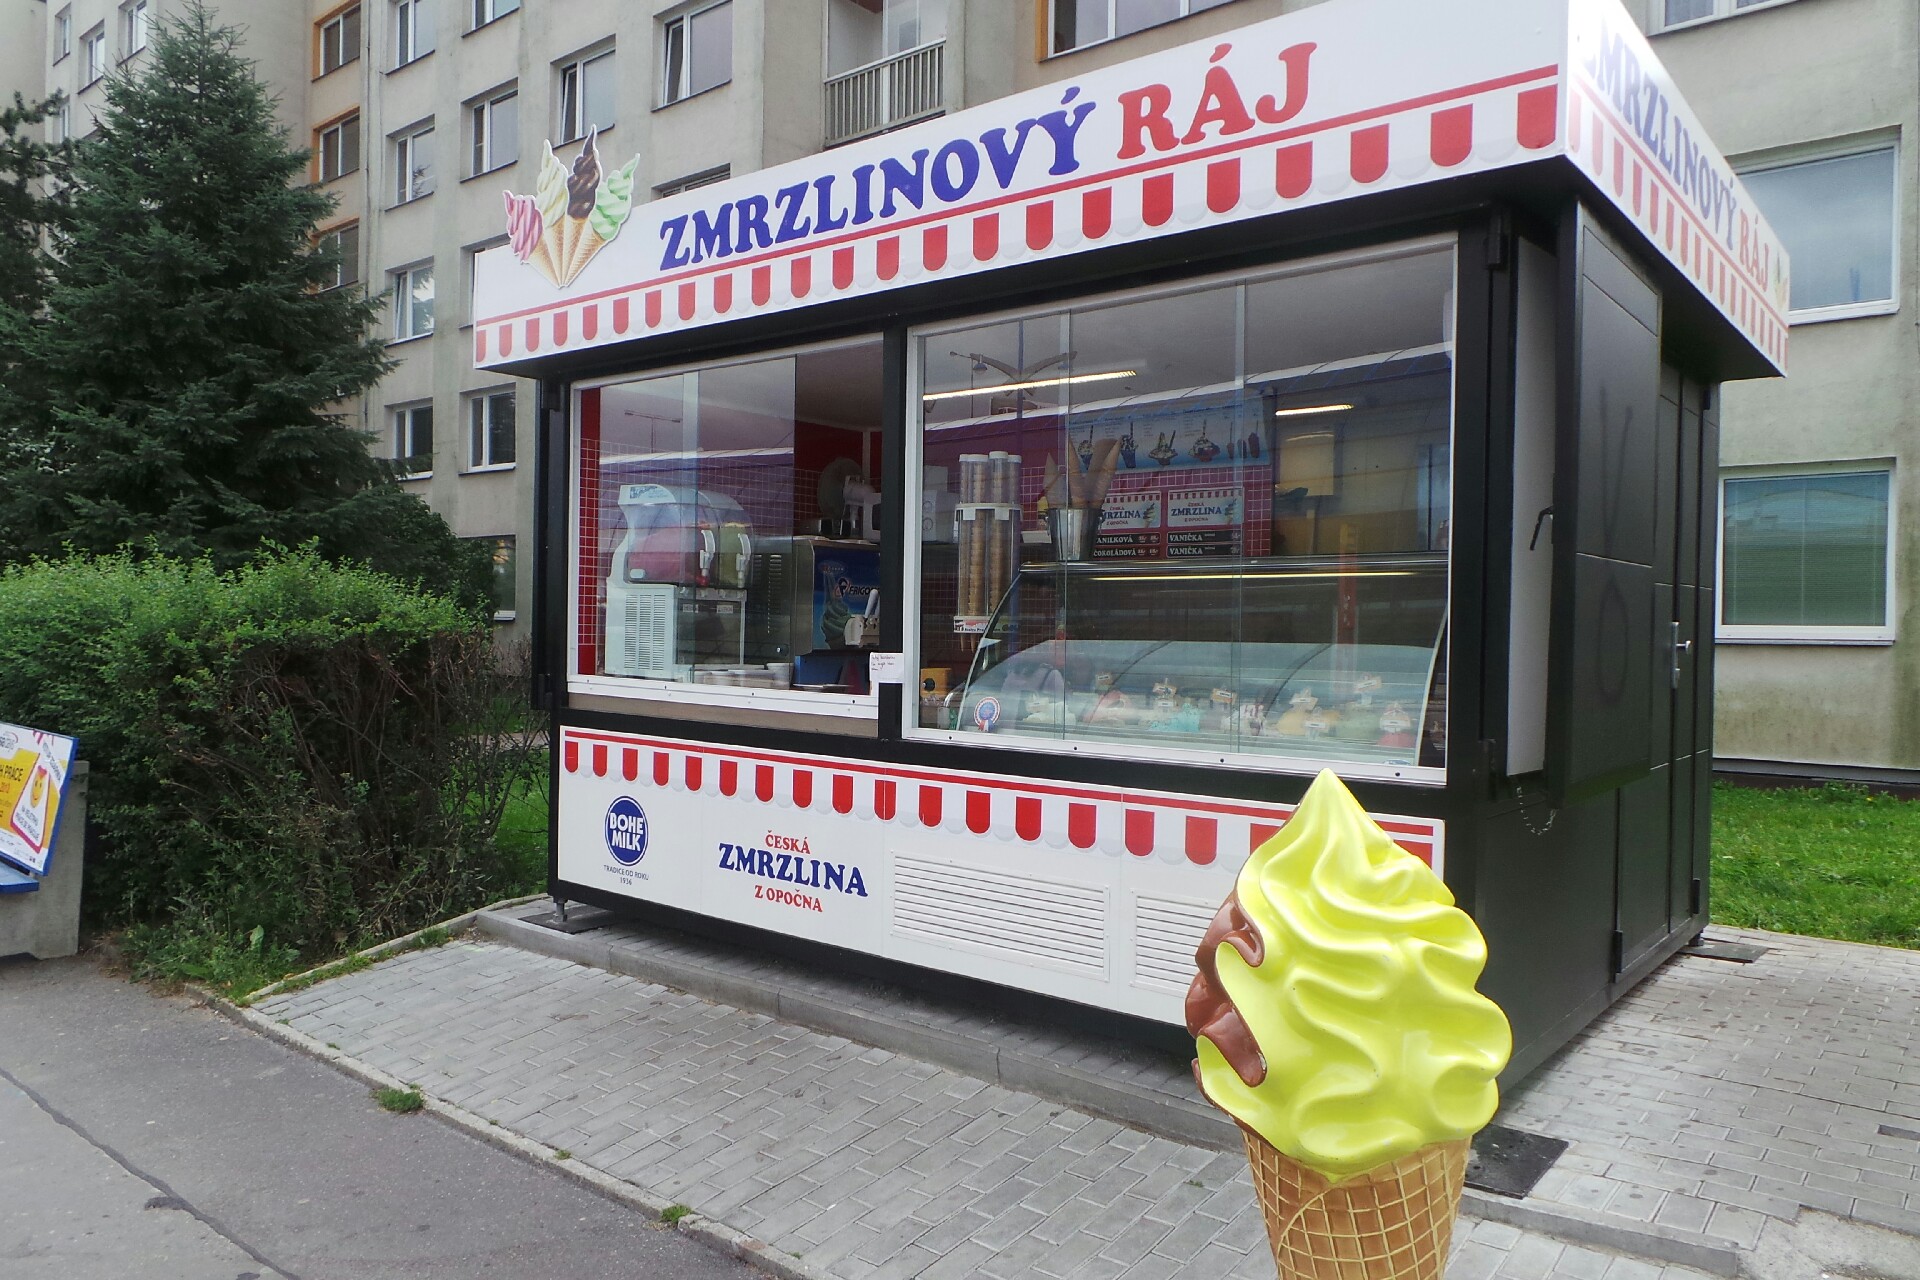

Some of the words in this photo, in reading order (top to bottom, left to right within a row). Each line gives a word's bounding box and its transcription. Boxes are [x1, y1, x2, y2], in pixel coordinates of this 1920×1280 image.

[659, 87, 1096, 271] ZMRZLINOVÝ
[1116, 43, 1318, 160] RÁJ
[1739, 208, 1769, 293] RÁJ
[1171, 506, 1222, 517] ZMRZLINA
[1169, 532, 1203, 542] VANIČKA
[1169, 545, 1204, 555] VANIČKA
[609, 812, 644, 835] BOHE
[611, 829, 641, 851] MILK
[765, 830, 811, 854] ČESKÁ
[603, 864, 625, 876] TRADICE
[625, 869, 634, 877] OD
[634, 871, 650, 880] ROKU
[718, 843, 869, 897] ZMRZLINA
[754, 885, 764, 899] Z
[766, 888, 823, 912] OPOČNA
